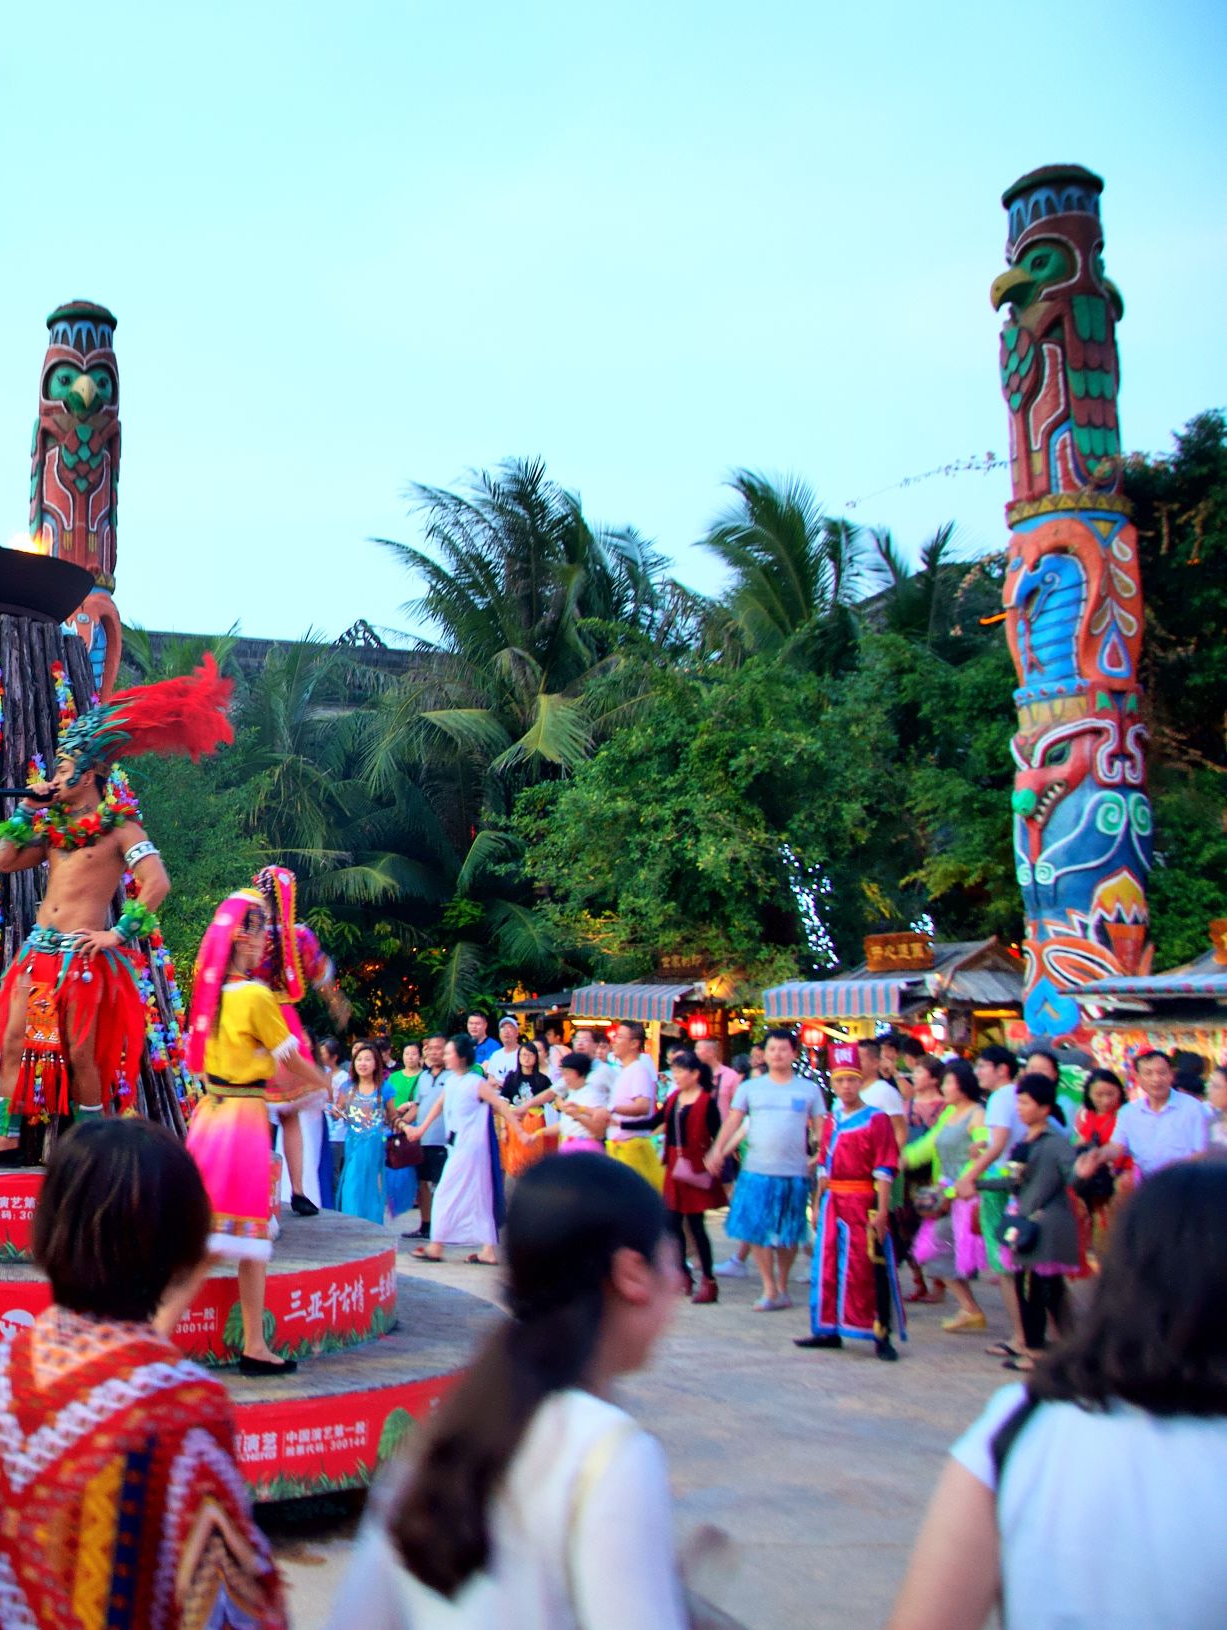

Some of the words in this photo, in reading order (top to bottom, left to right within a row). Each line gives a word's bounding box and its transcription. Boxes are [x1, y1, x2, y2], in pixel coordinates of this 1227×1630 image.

[283, 1273, 365, 1326] 三亚千古情
[176, 1321, 215, 1334] 300144
[285, 1421, 366, 1444] 中国演艺第一股
